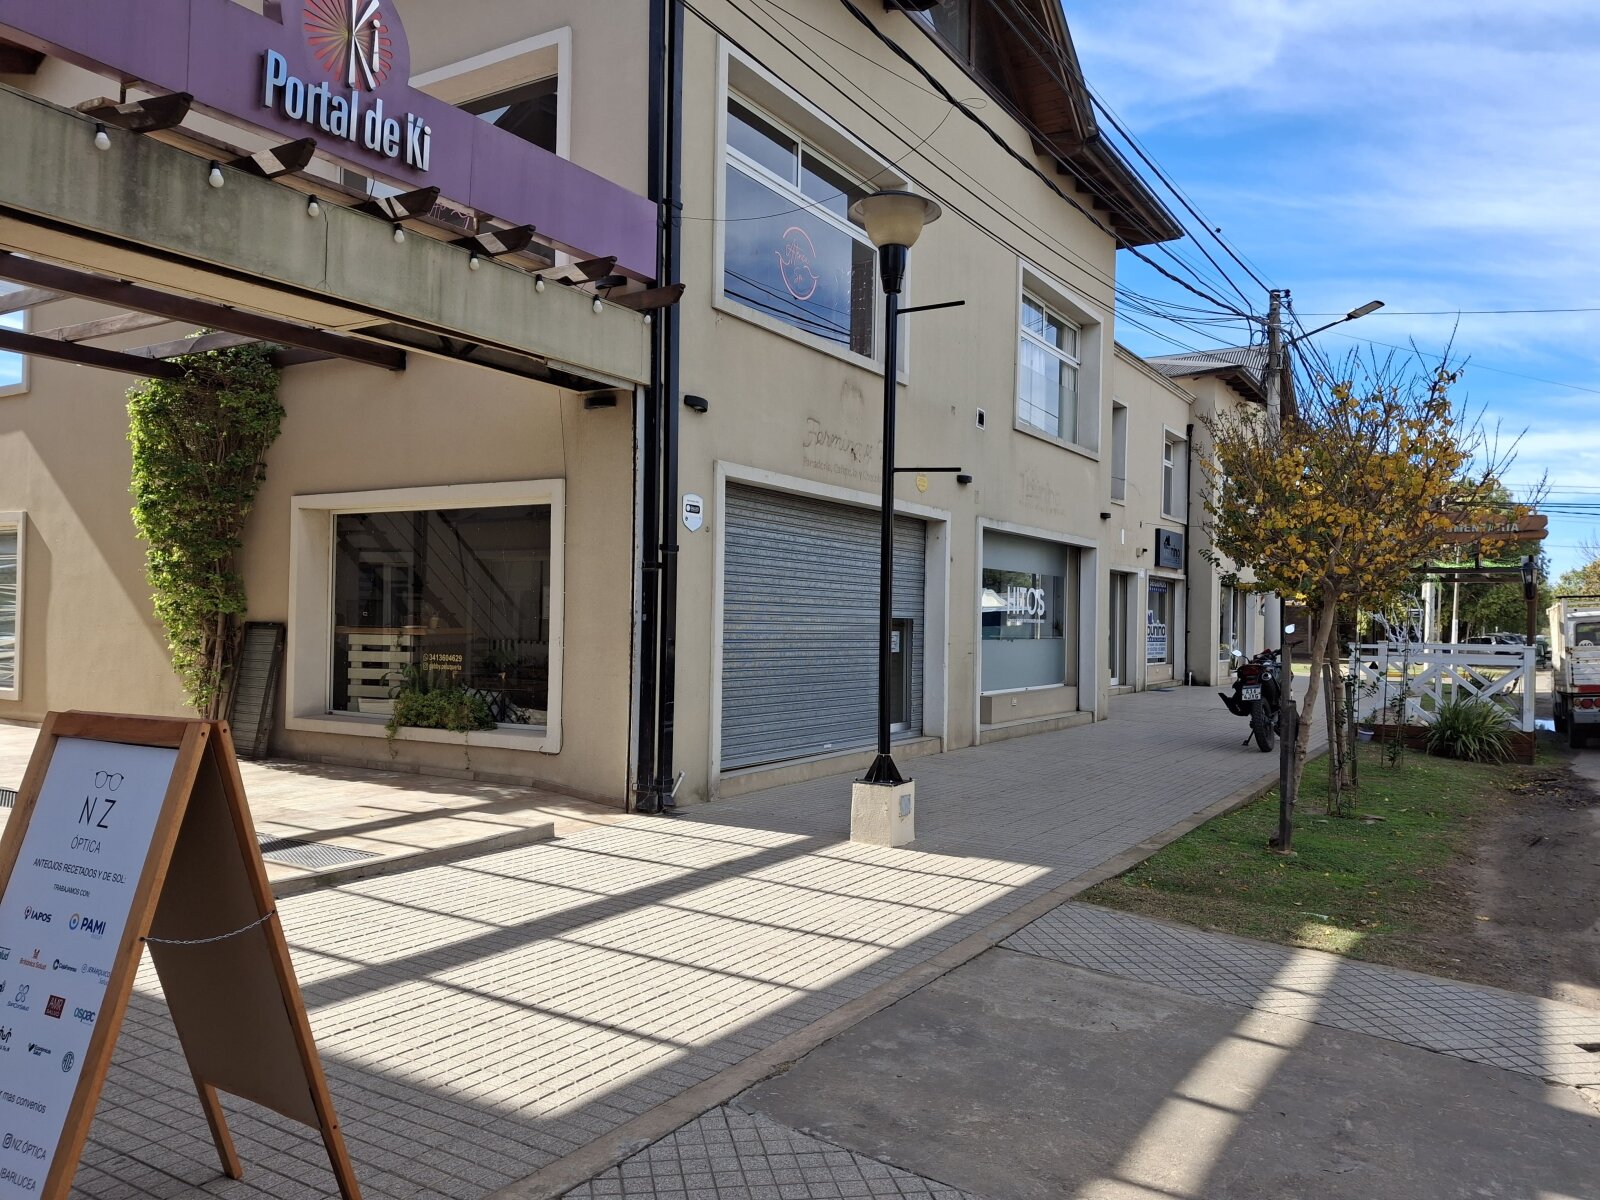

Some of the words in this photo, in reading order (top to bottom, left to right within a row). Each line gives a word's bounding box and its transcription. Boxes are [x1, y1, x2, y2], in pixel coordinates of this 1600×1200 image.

[264, 49, 359, 142] Portal
[364, 98, 400, 158] de
[406, 112, 432, 172] Ki
[1007, 586, 1045, 616] HITOS
[78, 795, 117, 829] NZ
[71, 834, 101, 854] ÓPTICA
[33, 858, 63, 872] ANTEOJOS
[62, 863, 98, 879] RECETADOS
[102, 871, 112, 881] DE
[31, 910, 52, 923] IAPOS
[80, 917, 107, 935] PAMI
[73, 1007, 96, 1022] ospac
[3, 1091, 16, 1103] mas
[16, 1096, 47, 1114] convenios
[12, 1138, 23, 1151] NZ
[22, 1139, 47, 1161] ÓPTICA
